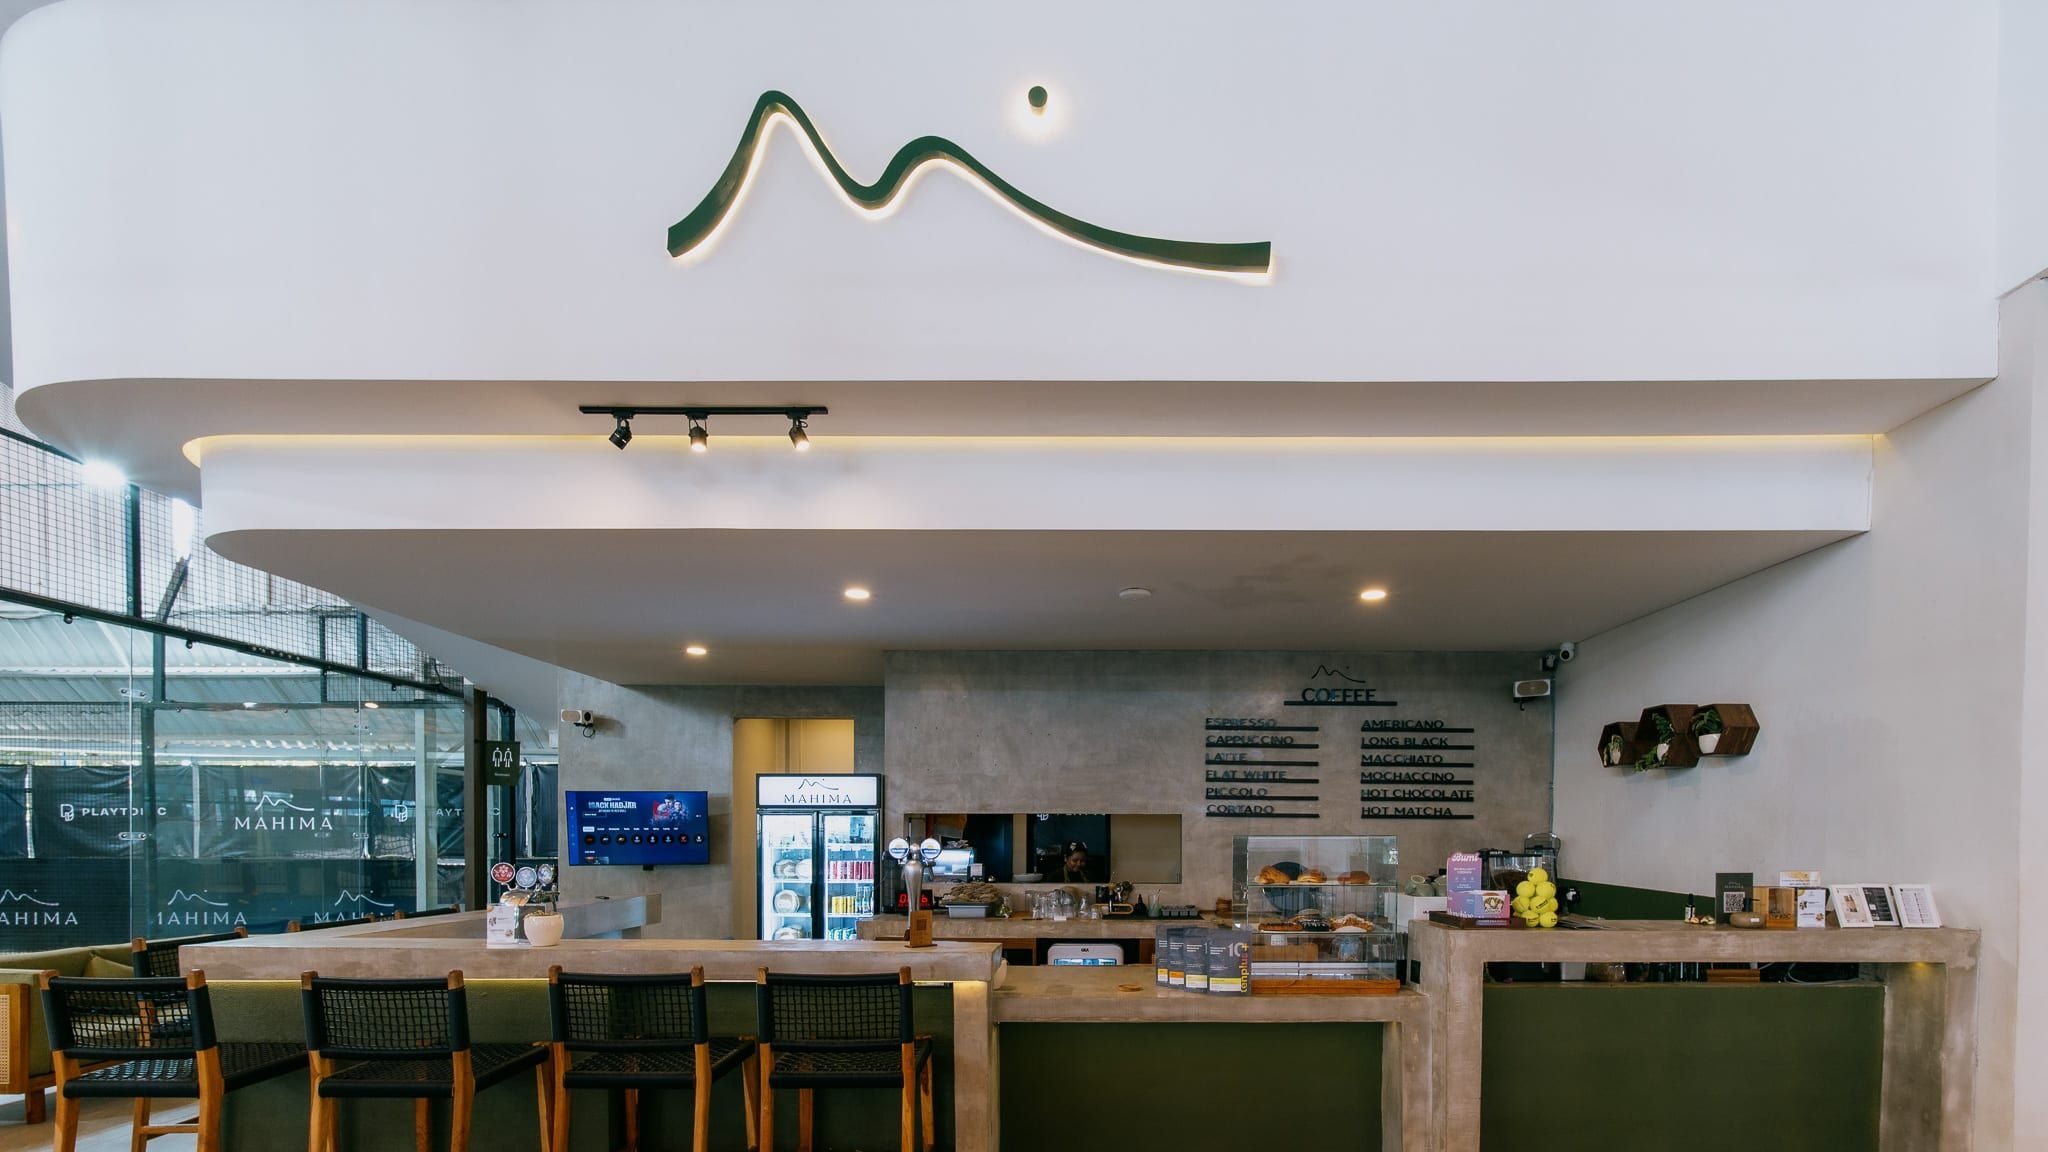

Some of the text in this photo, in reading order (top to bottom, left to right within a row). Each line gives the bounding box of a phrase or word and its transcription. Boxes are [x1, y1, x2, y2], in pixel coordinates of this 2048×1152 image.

[1301, 687, 1377, 702] COFFEE
[1205, 718, 1277, 727] ESPRESSO
[1361, 719, 1444, 729] AMERICANO
[1206, 735, 1294, 745] CAPPUCCINO
[1361, 736, 1448, 746] LONG BLACK
[1206, 752, 1248, 761] LATTE
[1361, 754, 1443, 764] MACCHIATO
[1206, 770, 1288, 780] FLAT WHITE
[1361, 771, 1455, 781] MOCHACCINO
[1206, 787, 1268, 797] PICCOLO
[1361, 789, 1474, 799] HOT CHOCOLATE
[784, 794, 852, 804] MAHIMA
[82, 807, 167, 817] PLAYTOC
[1207, 804, 1275, 814] CORTADO
[1361, 806, 1453, 816] HOT MATCHA
[234, 816, 333, 831] MAHIMA
[0, 911, 79, 926] AHIMA
